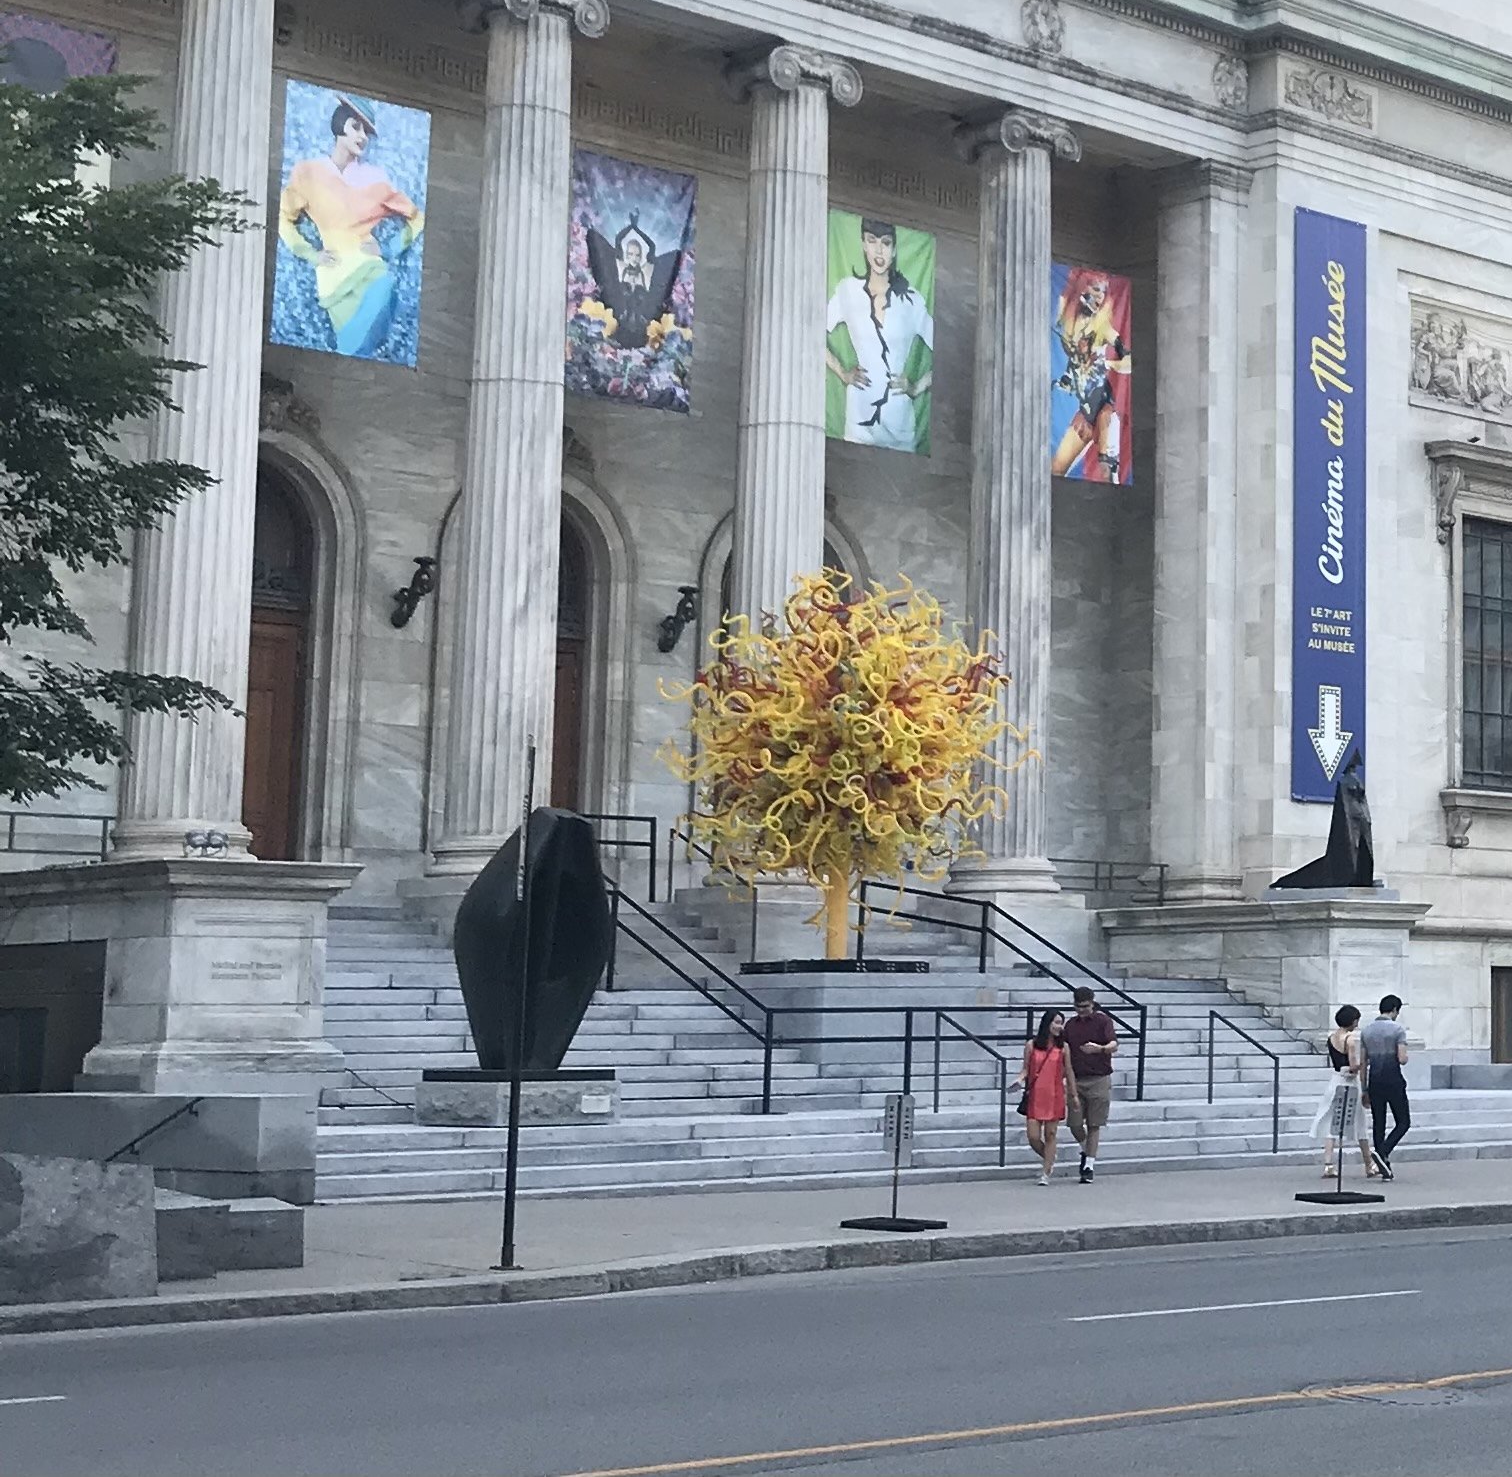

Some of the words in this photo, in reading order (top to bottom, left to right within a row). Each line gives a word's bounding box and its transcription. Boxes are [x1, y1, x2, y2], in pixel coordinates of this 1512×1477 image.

[1308, 260, 1354, 394] Musée
[1320, 398, 1345, 447] du
[1317, 455, 1345, 585] Cinéma
[1310, 607, 1323, 618] LE
[1333, 610, 1352, 621] ART
[1312, 622, 1351, 637] S'INVITE
[1308, 638, 1322, 649] AU
